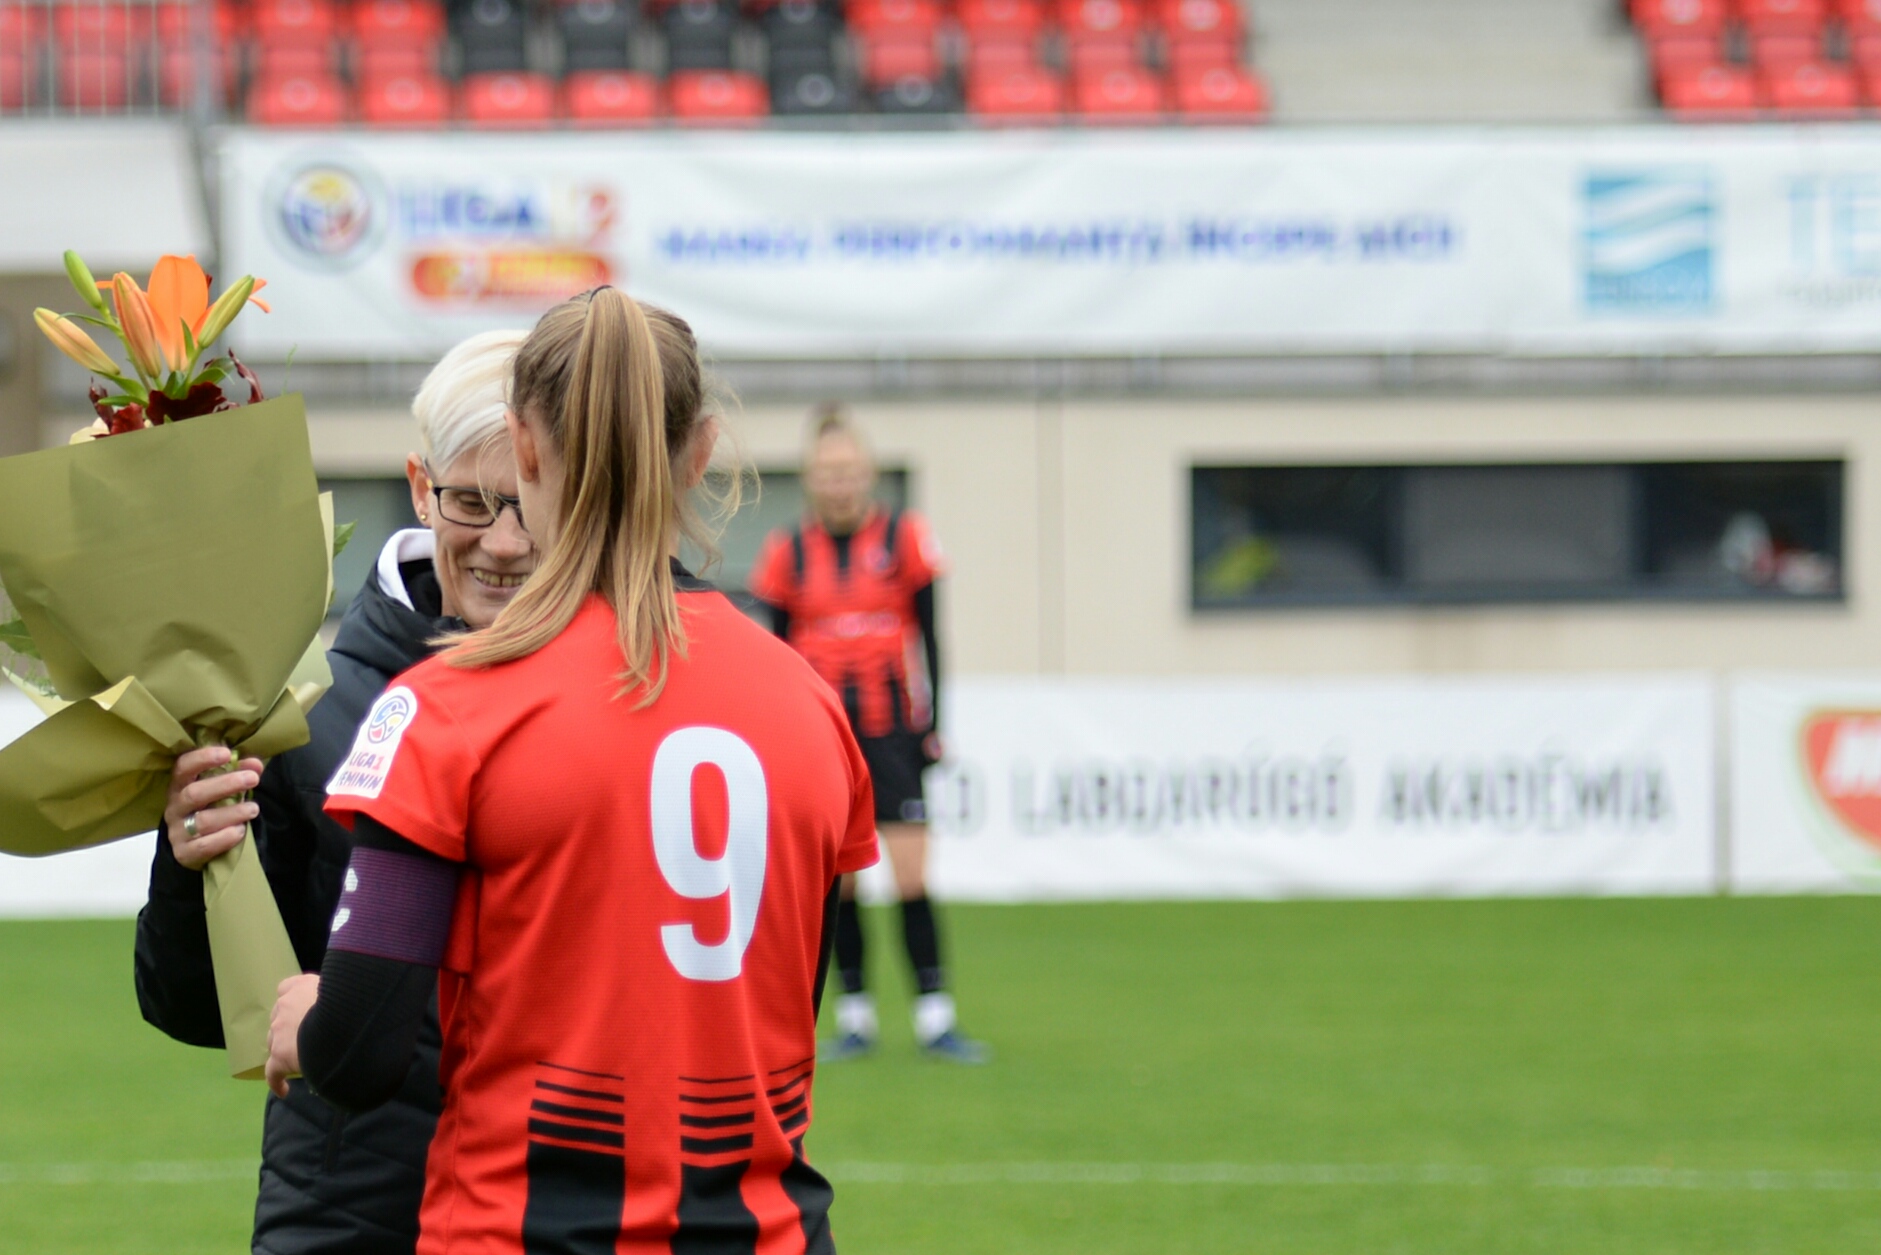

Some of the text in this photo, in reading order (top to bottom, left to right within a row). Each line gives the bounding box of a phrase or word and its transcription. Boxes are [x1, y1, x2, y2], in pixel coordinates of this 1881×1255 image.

[349, 751, 385, 771] LIGA 1
[651, 726, 768, 981] 9
